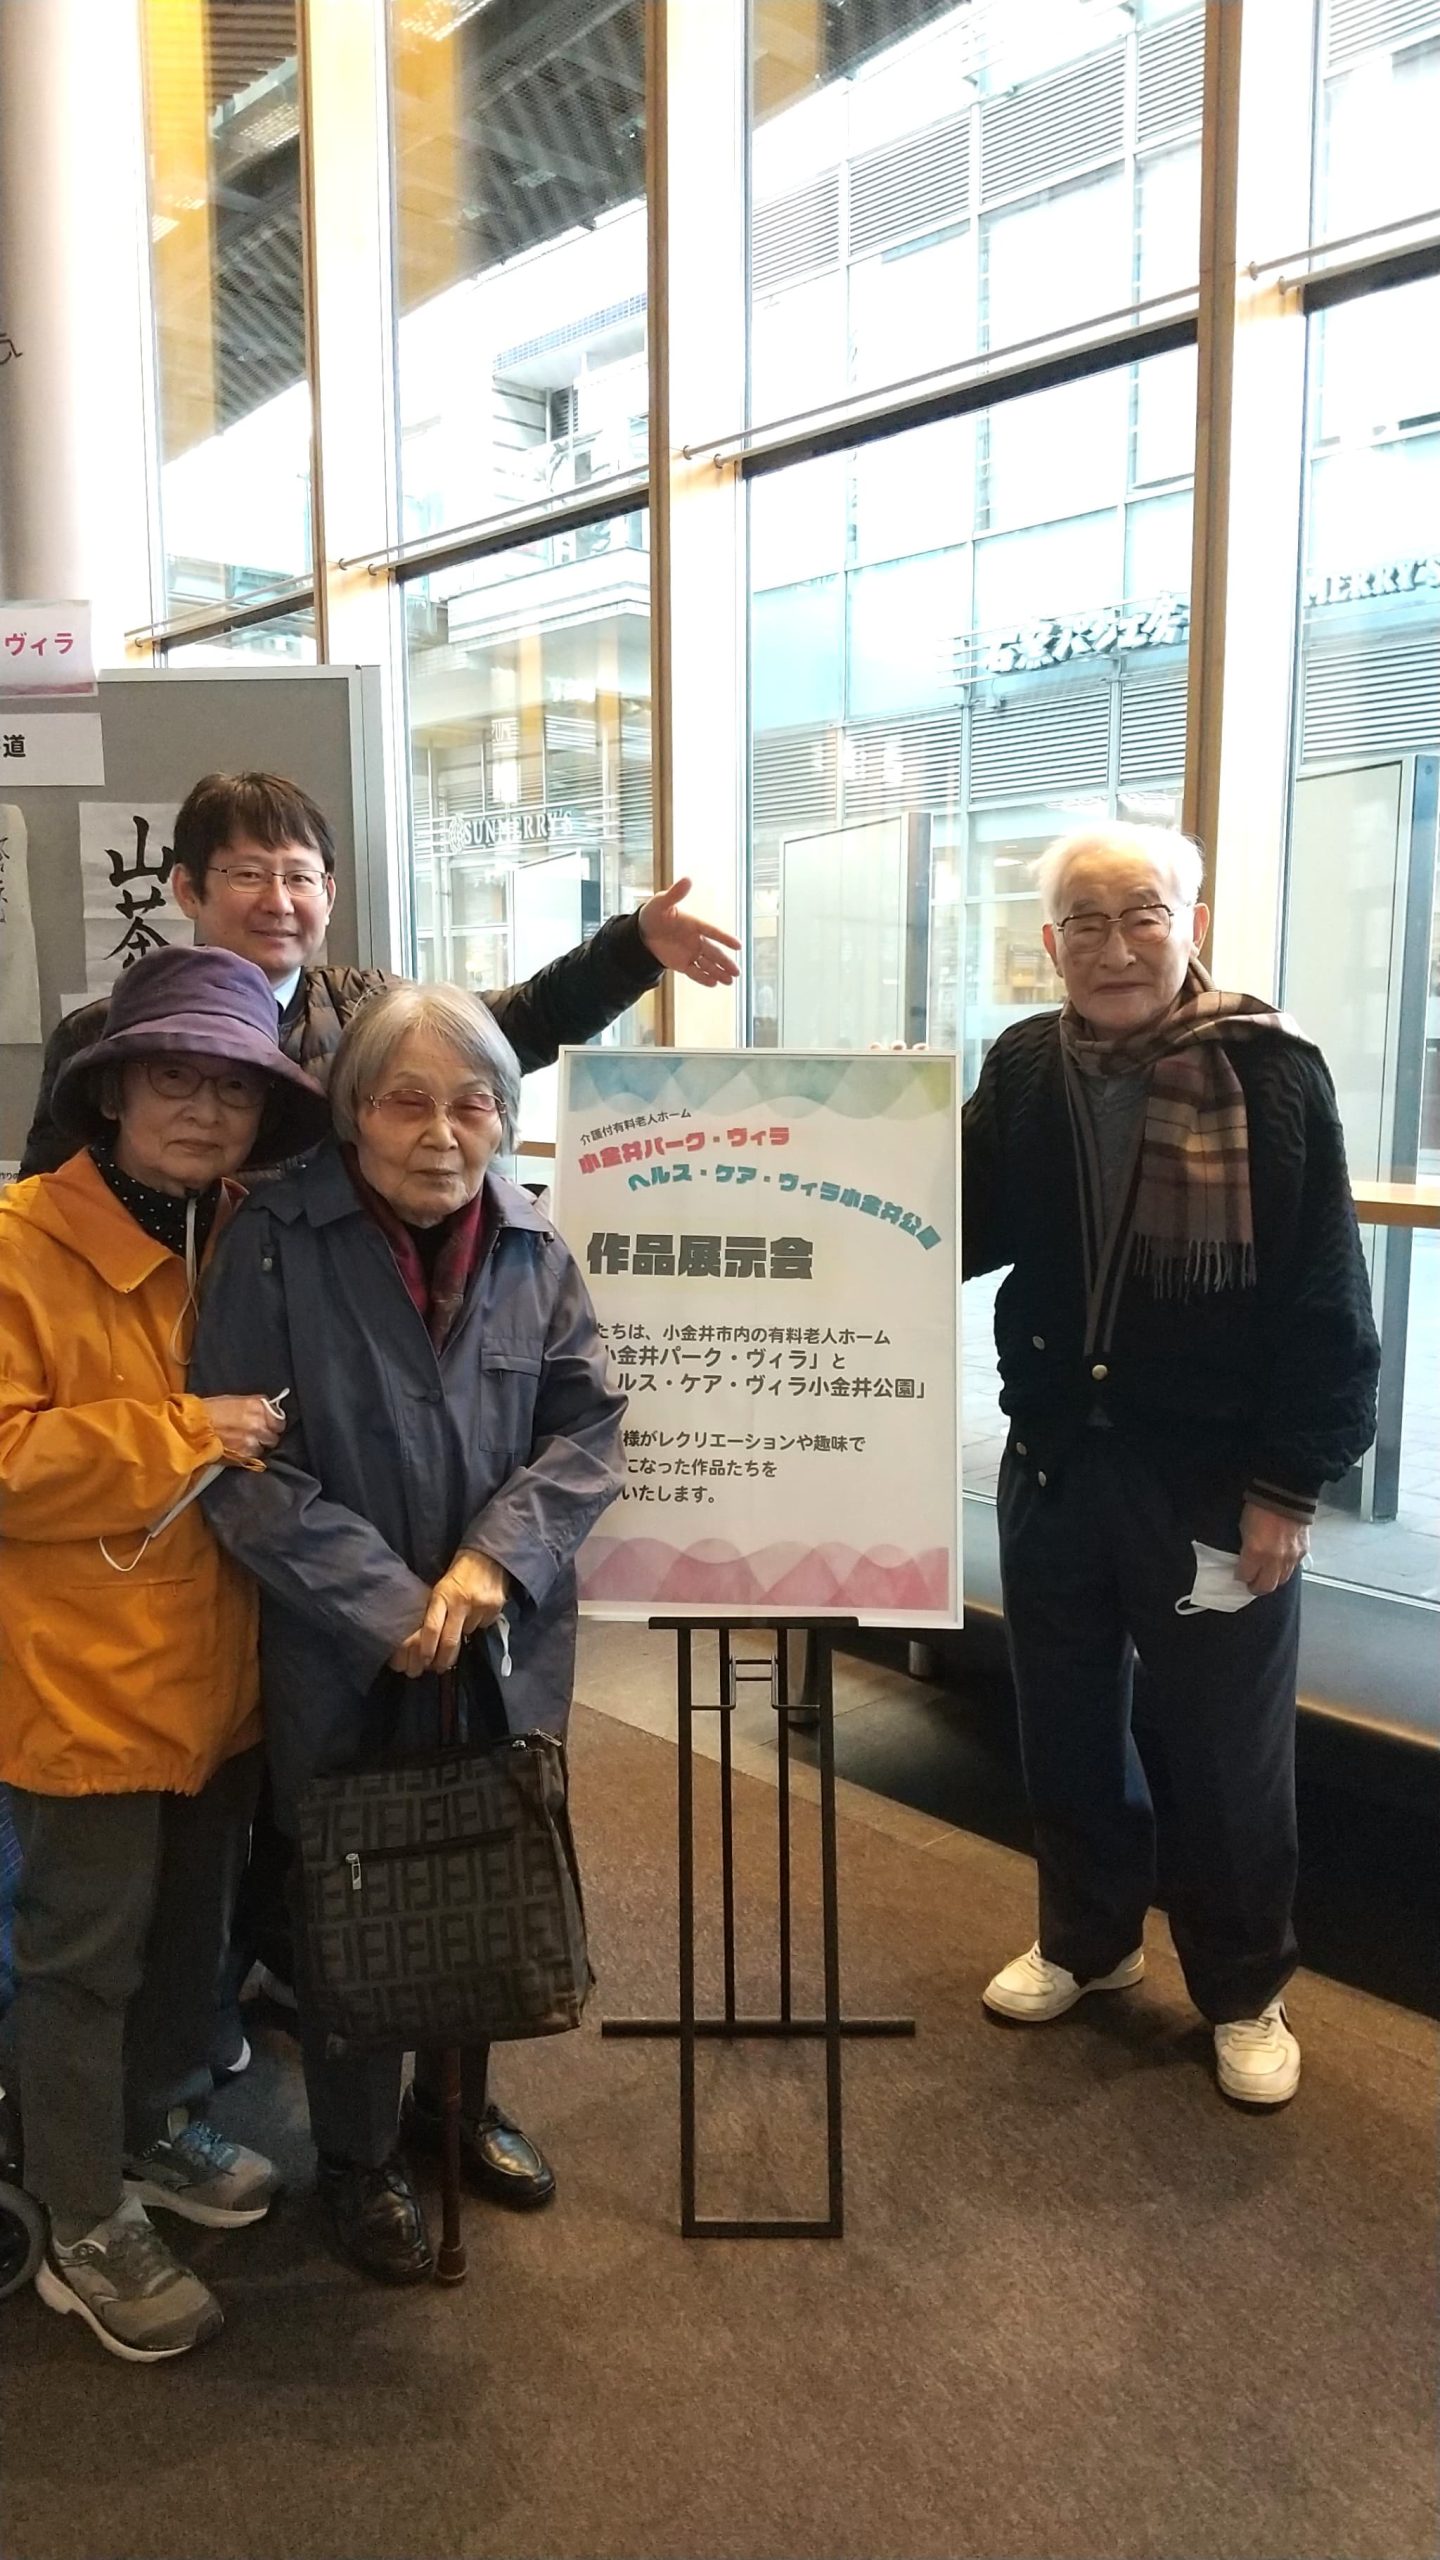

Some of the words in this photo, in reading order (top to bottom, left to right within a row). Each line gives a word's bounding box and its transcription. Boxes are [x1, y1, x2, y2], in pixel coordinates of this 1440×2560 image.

[2, 733, 26, 758] 道
[463, 809, 574, 846] SUNMERRY'S
[579, 1107, 692, 1146] 介護付有料老人ホーム
[577, 1126, 790, 1175] 小金井パーク・ヴィラ
[586, 1232, 814, 1280] 作品展示会
[623, 1430, 866, 1452] 様がレクリエーションや趣味で
